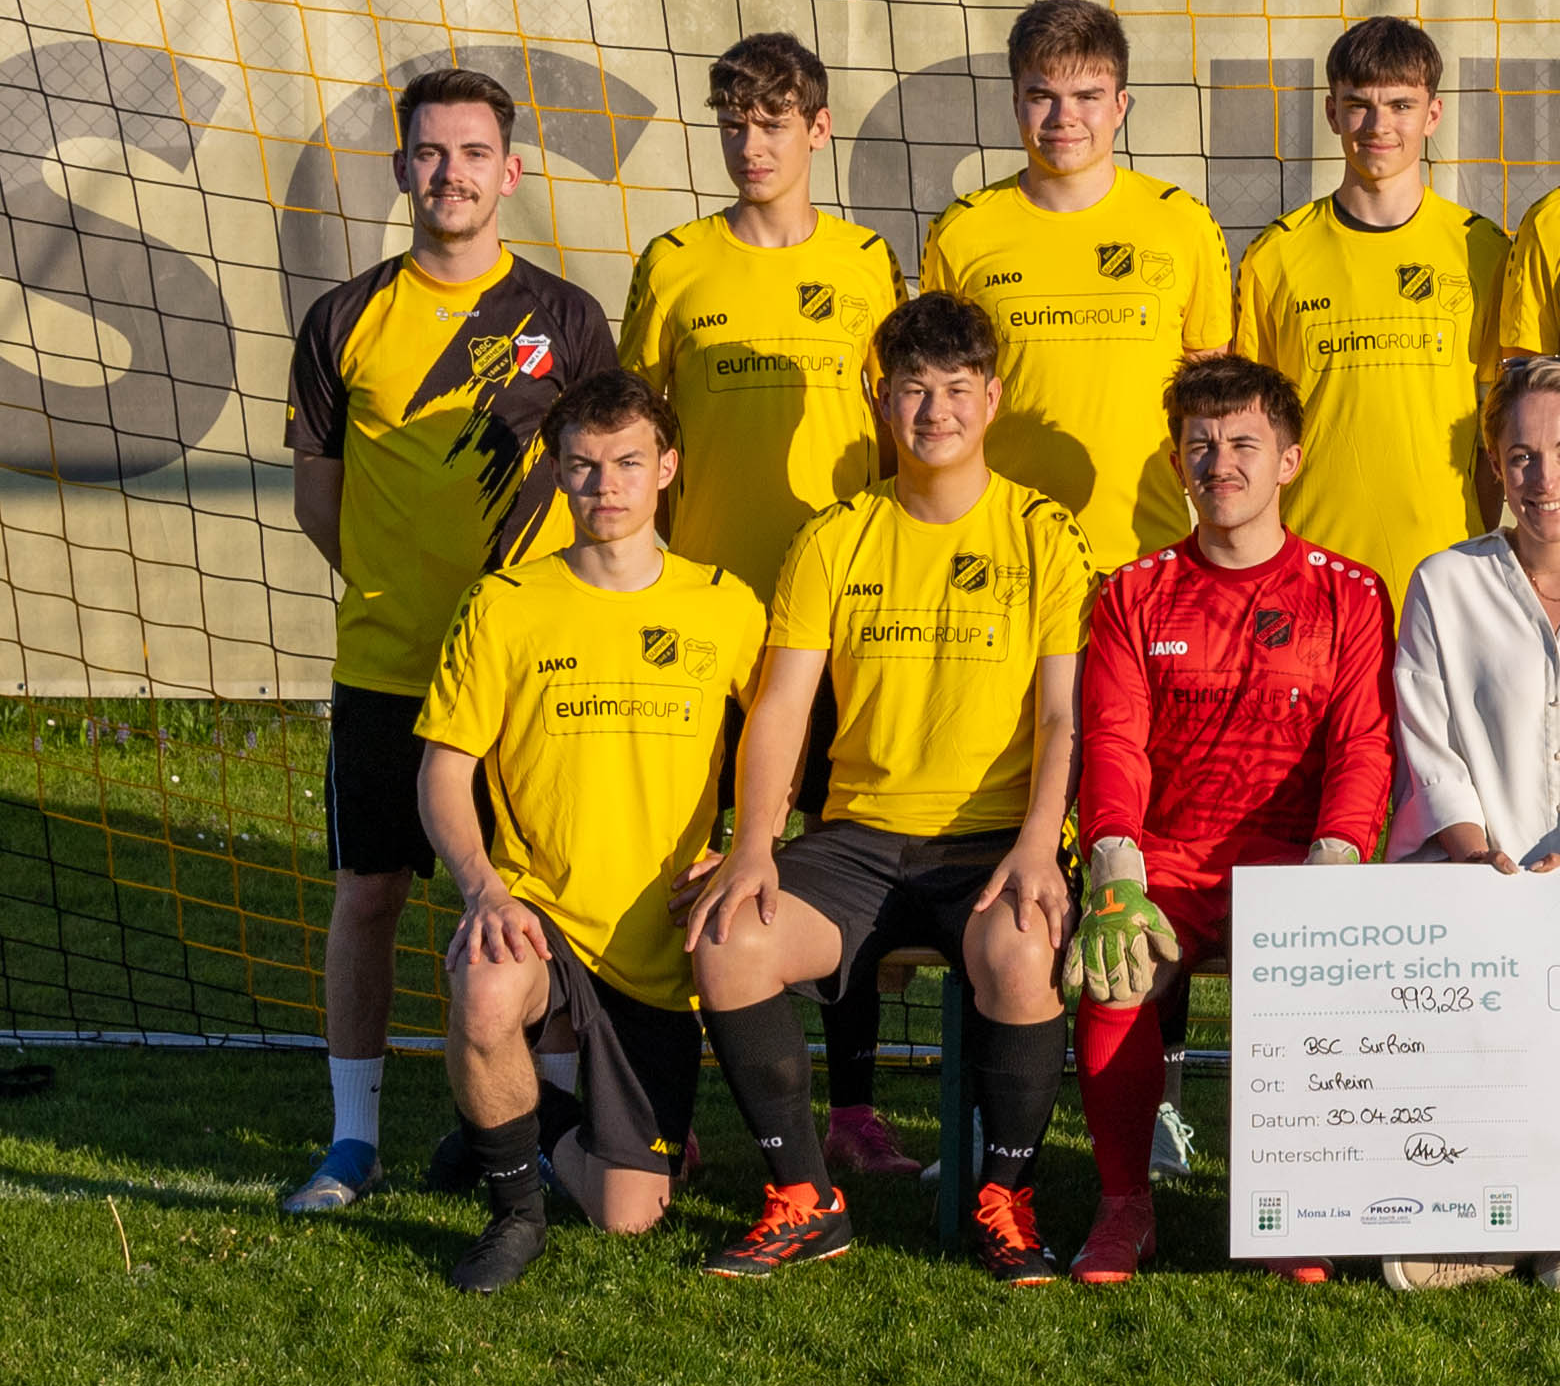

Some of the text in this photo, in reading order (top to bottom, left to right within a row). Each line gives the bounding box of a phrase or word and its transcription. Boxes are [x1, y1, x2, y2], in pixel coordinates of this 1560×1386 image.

[984, 272, 1023, 287] JAKO
[1295, 298, 1330, 314] JAKO
[691, 313, 727, 331] JAKO
[1010, 306, 1134, 326] eurimGROUP
[1318, 331, 1432, 355] eurimGROUP
[716, 351, 833, 375] eurimGROUP
[844, 583, 884, 596] JAKO
[861, 621, 981, 644] eurimGROUP
[1149, 640, 1188, 656] JAKO
[537, 657, 577, 673] JAKO
[556, 695, 679, 718] eurimGROUP
[1252, 924, 1448, 949] eurimGROUP
[1252, 955, 1520, 987] engagiert sich mit
[1479, 991, 1502, 1012] €
[1251, 1043, 1286, 1058] Für:
[1303, 1036, 1343, 1056] BSC
[1164, 1051, 1185, 1062] AKO
[1251, 1079, 1285, 1094] Ort:
[1251, 1106, 1437, 1128] Datum: 30.04.2025
[650, 1138, 682, 1156] JAKO
[760, 1137, 783, 1148] KO
[987, 1143, 1034, 1158] JAKO
[1251, 1147, 1365, 1164] Unterschrift:
[1297, 1207, 1351, 1219] Mona Lisa
[1370, 1205, 1413, 1214] PROSAN
[1432, 1202, 1476, 1213] ALPHA
